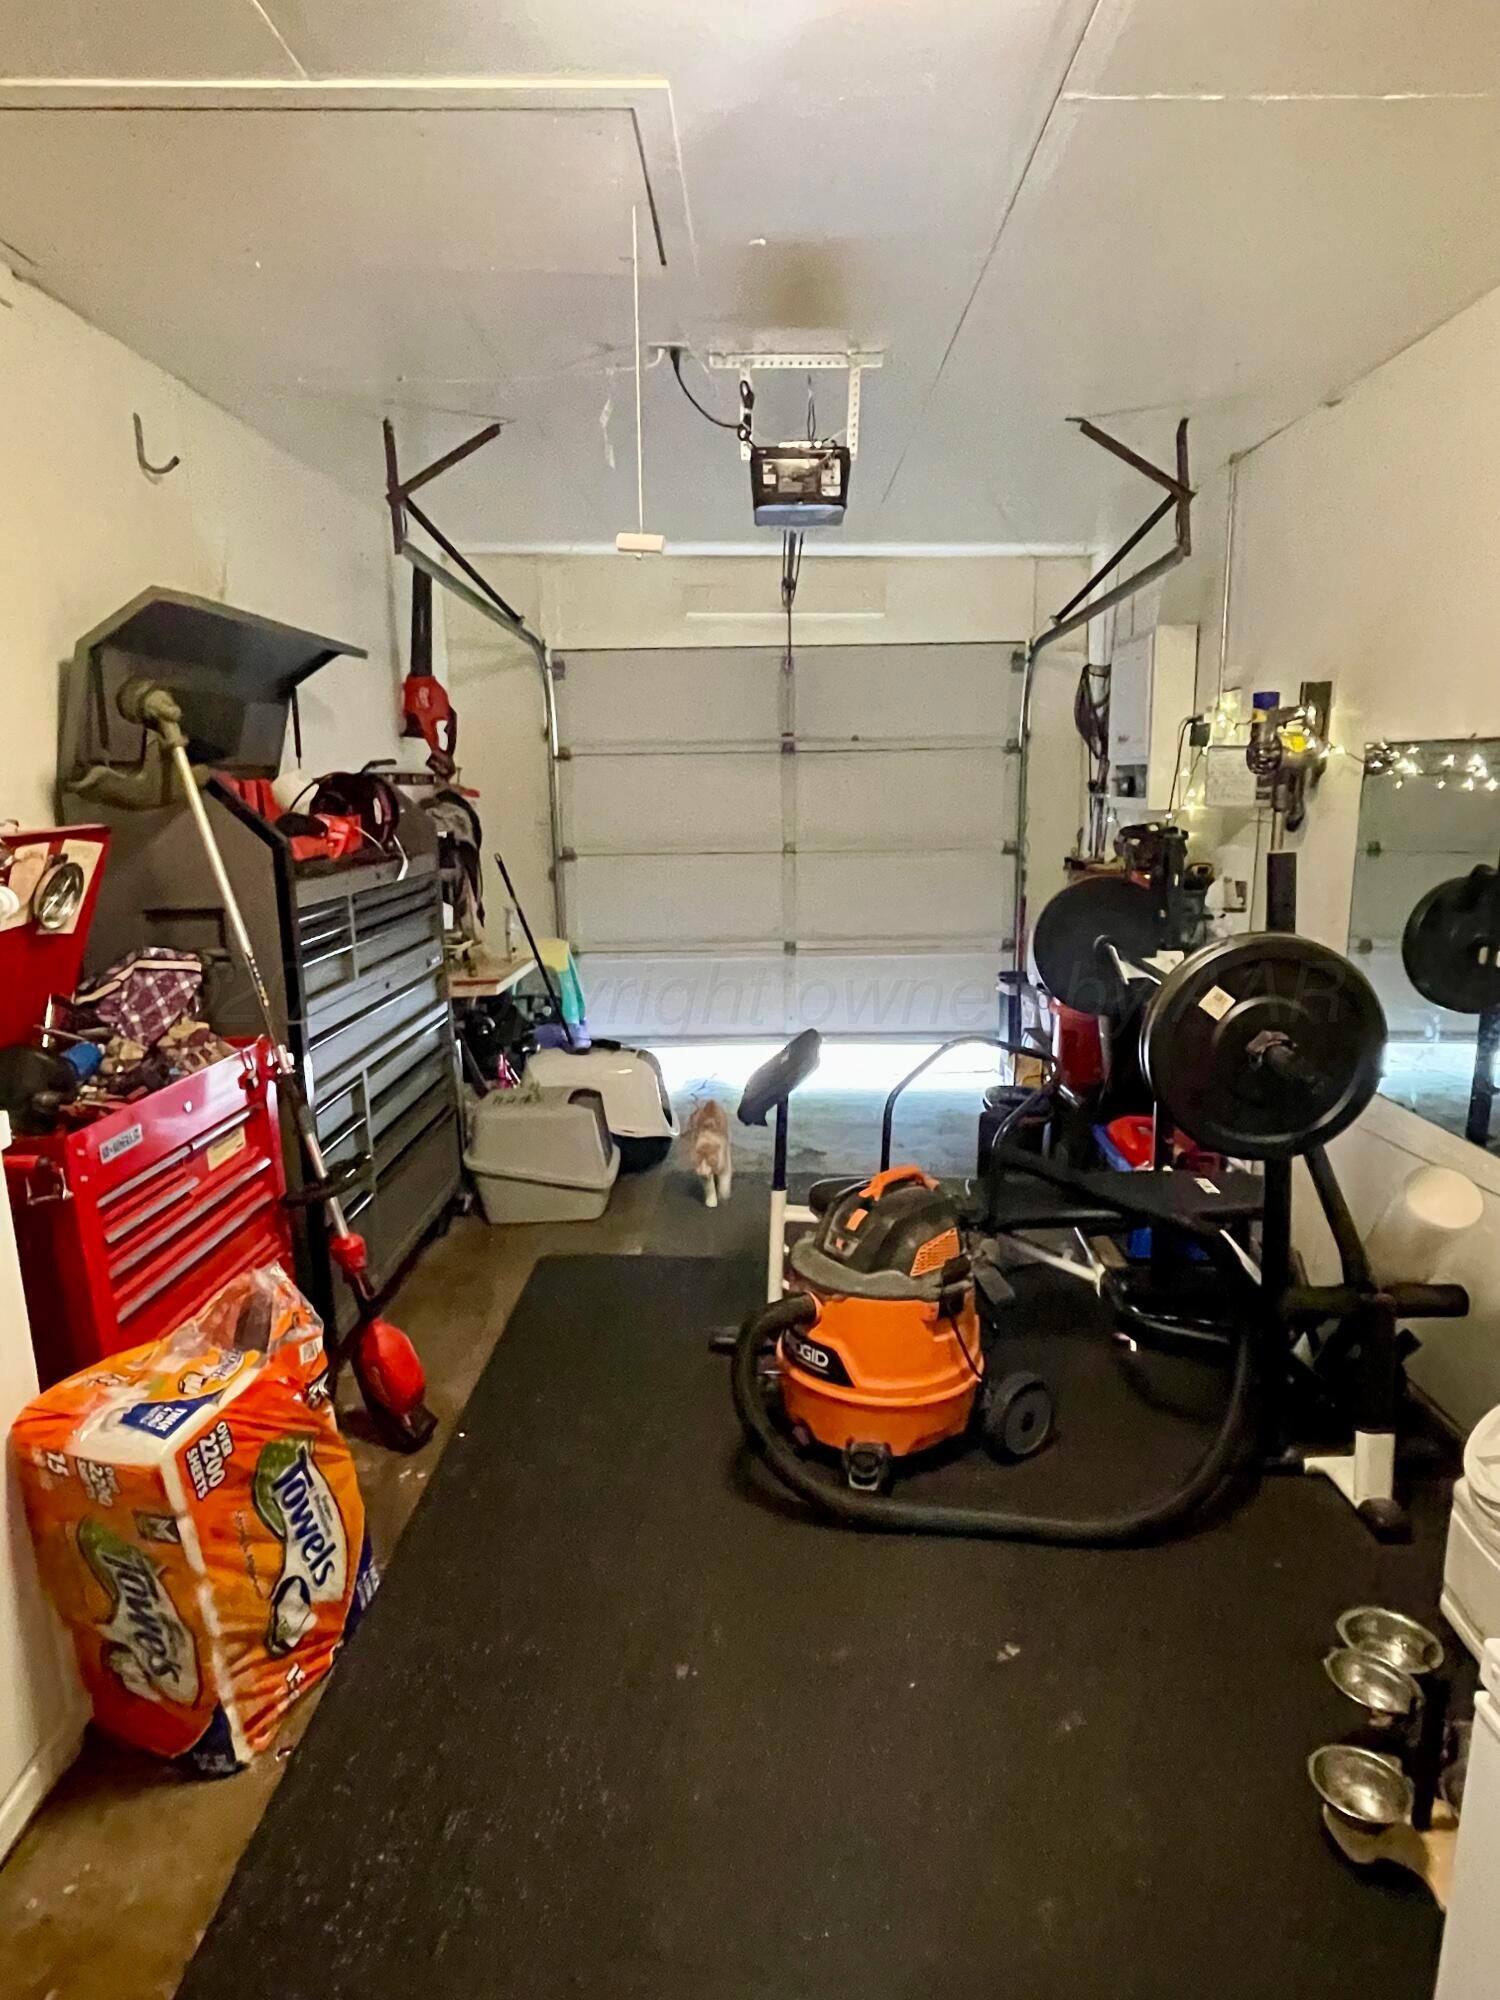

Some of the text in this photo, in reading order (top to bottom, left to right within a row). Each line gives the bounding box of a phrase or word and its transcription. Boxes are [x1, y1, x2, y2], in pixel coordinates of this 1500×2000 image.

[800, 1344, 830, 1367] GID
[199, 1432, 226, 1488] 2200
[216, 1420, 233, 1458] OVER
[186, 1447, 209, 1499] SHEETS
[271, 1444, 336, 1588] Towels
